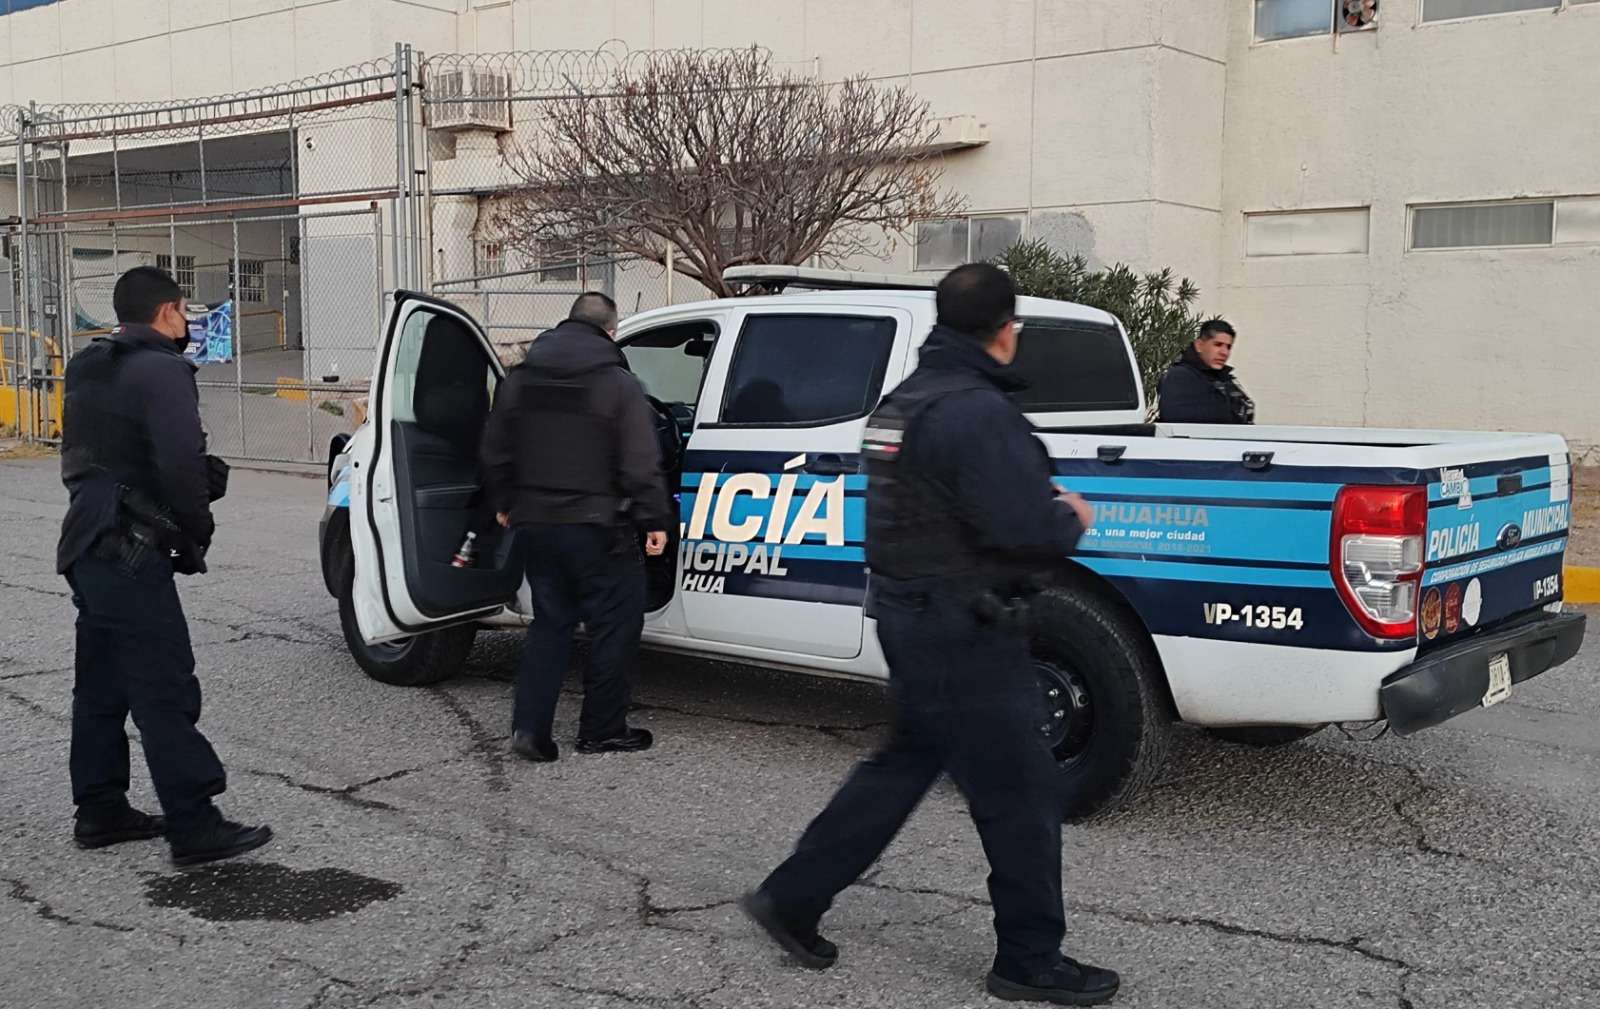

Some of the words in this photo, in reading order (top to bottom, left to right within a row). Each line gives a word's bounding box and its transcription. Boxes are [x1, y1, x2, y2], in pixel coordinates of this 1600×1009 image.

[680, 453, 844, 546] ICÍA
[1105, 528, 1126, 537] una
[1129, 529, 1163, 540] mejor
[1166, 529, 1206, 542] ciudad
[1429, 514, 1480, 560] POLICÍA
[1522, 504, 1568, 538] MUNICIPAL
[682, 541, 788, 576] ICIPAL
[682, 574, 726, 594] HUA
[1203, 602, 1304, 631] VP-1354
